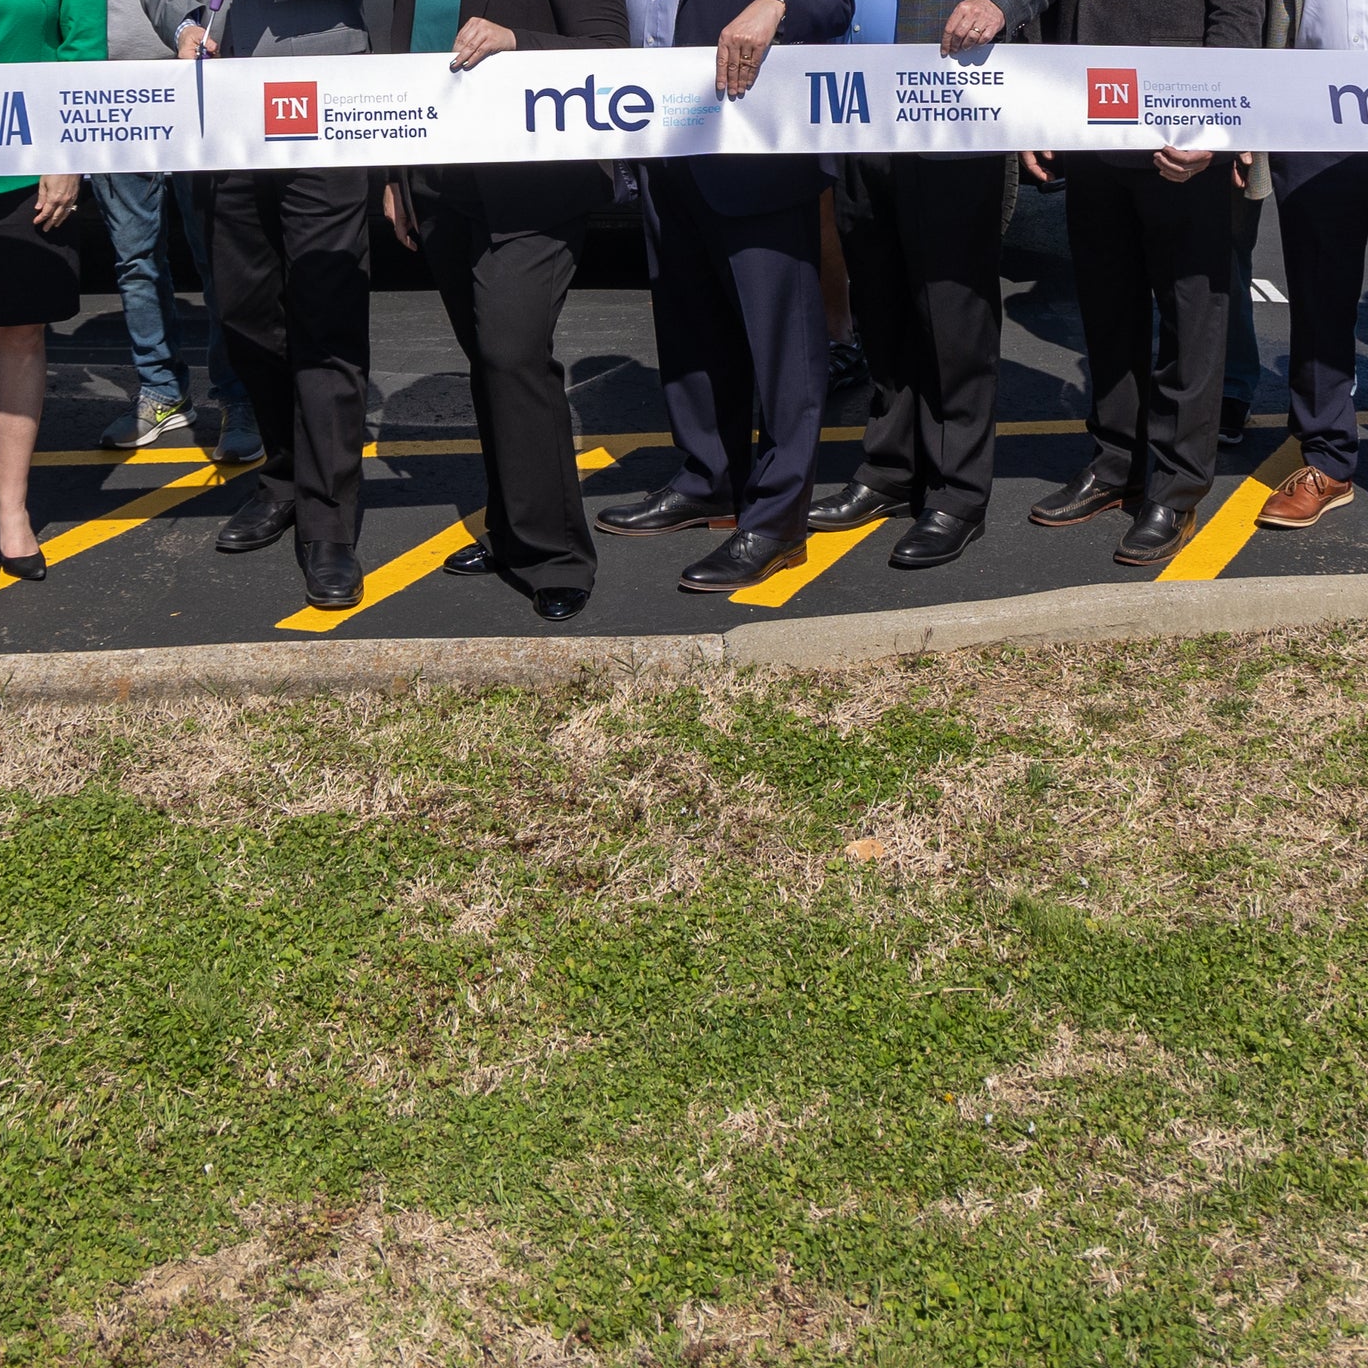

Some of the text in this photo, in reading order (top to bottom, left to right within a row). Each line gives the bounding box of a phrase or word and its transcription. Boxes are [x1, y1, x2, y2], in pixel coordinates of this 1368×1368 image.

[896, 72, 1004, 86] TENNESSEE
[1144, 80, 1222, 93] Department of
[59, 88, 176, 105] TENNESSEE
[324, 92, 408, 106] Department of
[662, 94, 701, 104] Middle
[805, 72, 870, 124] TVA
[896, 90, 964, 104] VALLEY
[1095, 84, 1129, 104] TN
[1144, 94, 1251, 108] Environment &
[272, 97, 308, 120] TN
[525, 74, 654, 132] mte
[662, 104, 721, 115] Tennessee
[60, 108, 133, 124] VALLEY
[324, 106, 438, 122] Environment &
[662, 116, 704, 127] Electric
[896, 107, 1002, 122] AUTHORITY
[1144, 112, 1242, 126] Conservation
[60, 126, 174, 143] AUTHORITY
[324, 124, 427, 140] Conservation
